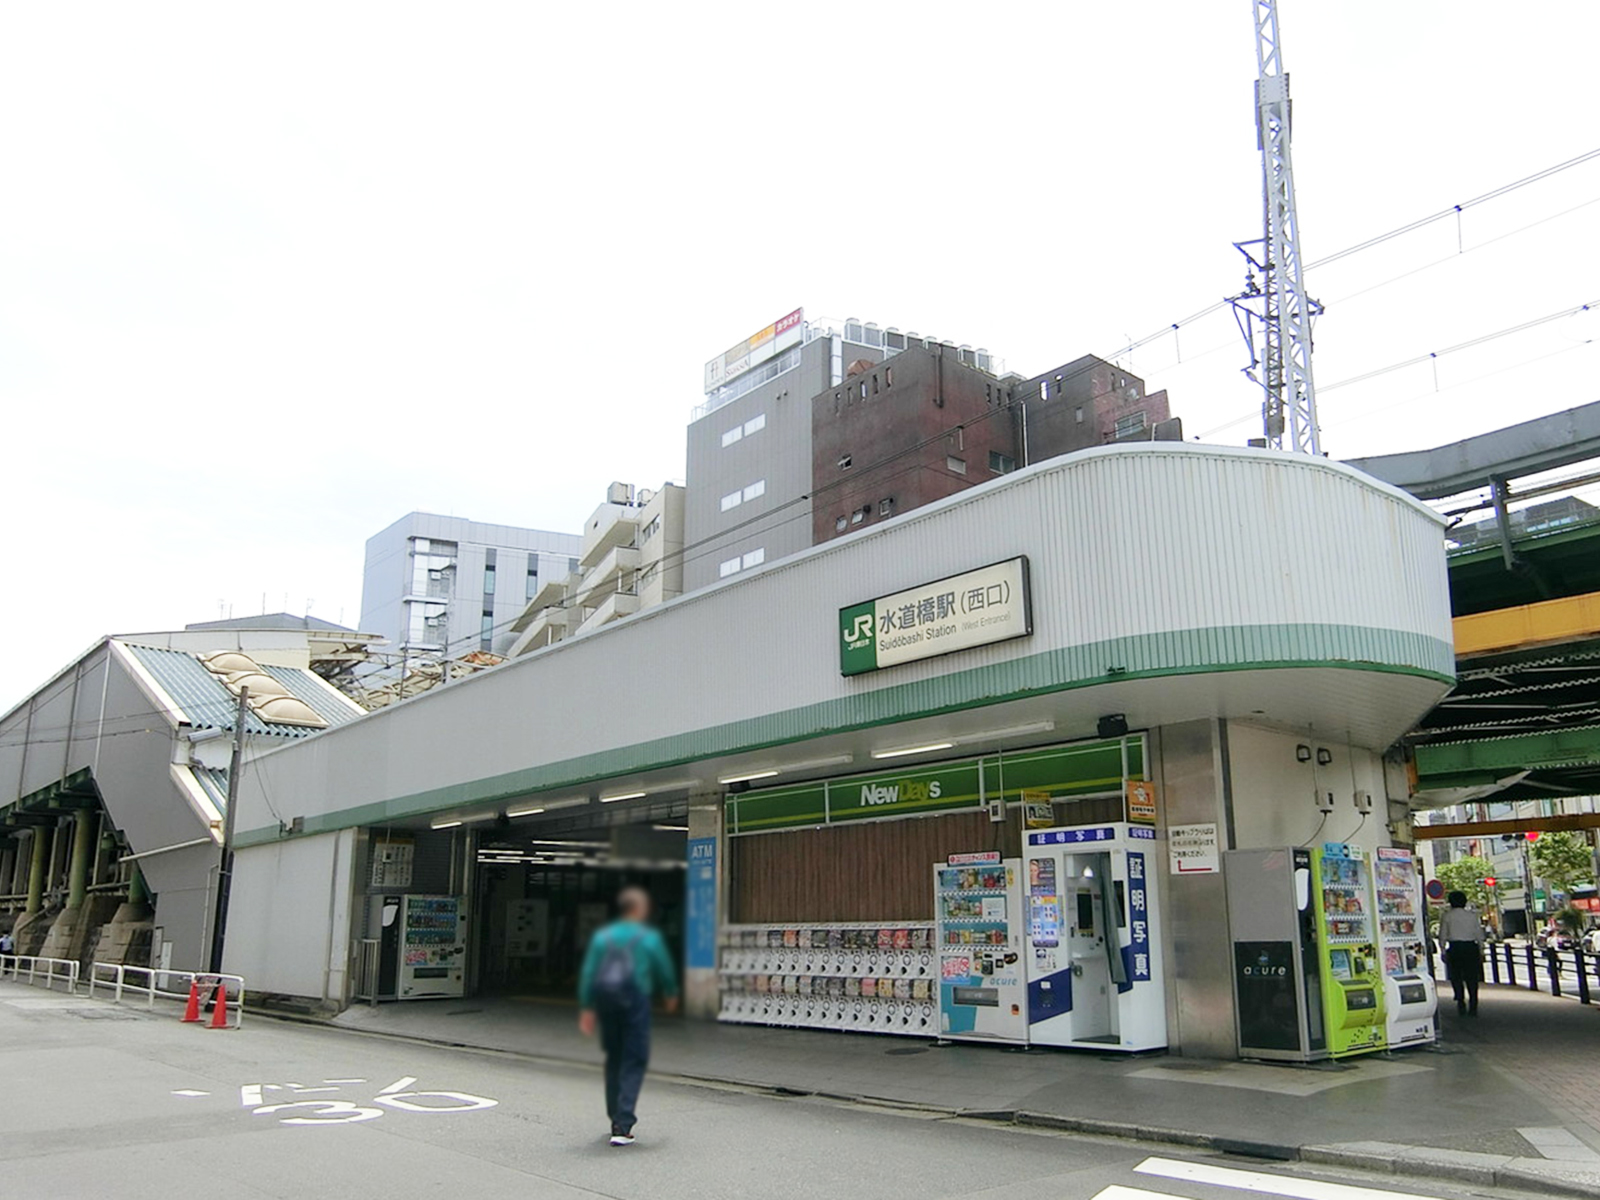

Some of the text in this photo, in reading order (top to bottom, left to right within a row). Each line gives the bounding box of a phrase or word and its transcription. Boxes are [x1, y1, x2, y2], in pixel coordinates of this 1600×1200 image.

[844, 614, 873, 642] JR
[926, 624, 957, 640] Station
[861, 781, 941, 806] NewDays
[1037, 829, 1105, 844] 証明写真
[692, 845, 713, 859] ATM
[1130, 858, 1148, 976] 証明写真
[1243, 966, 1287, 975] acure
[989, 977, 1018, 986] acure
